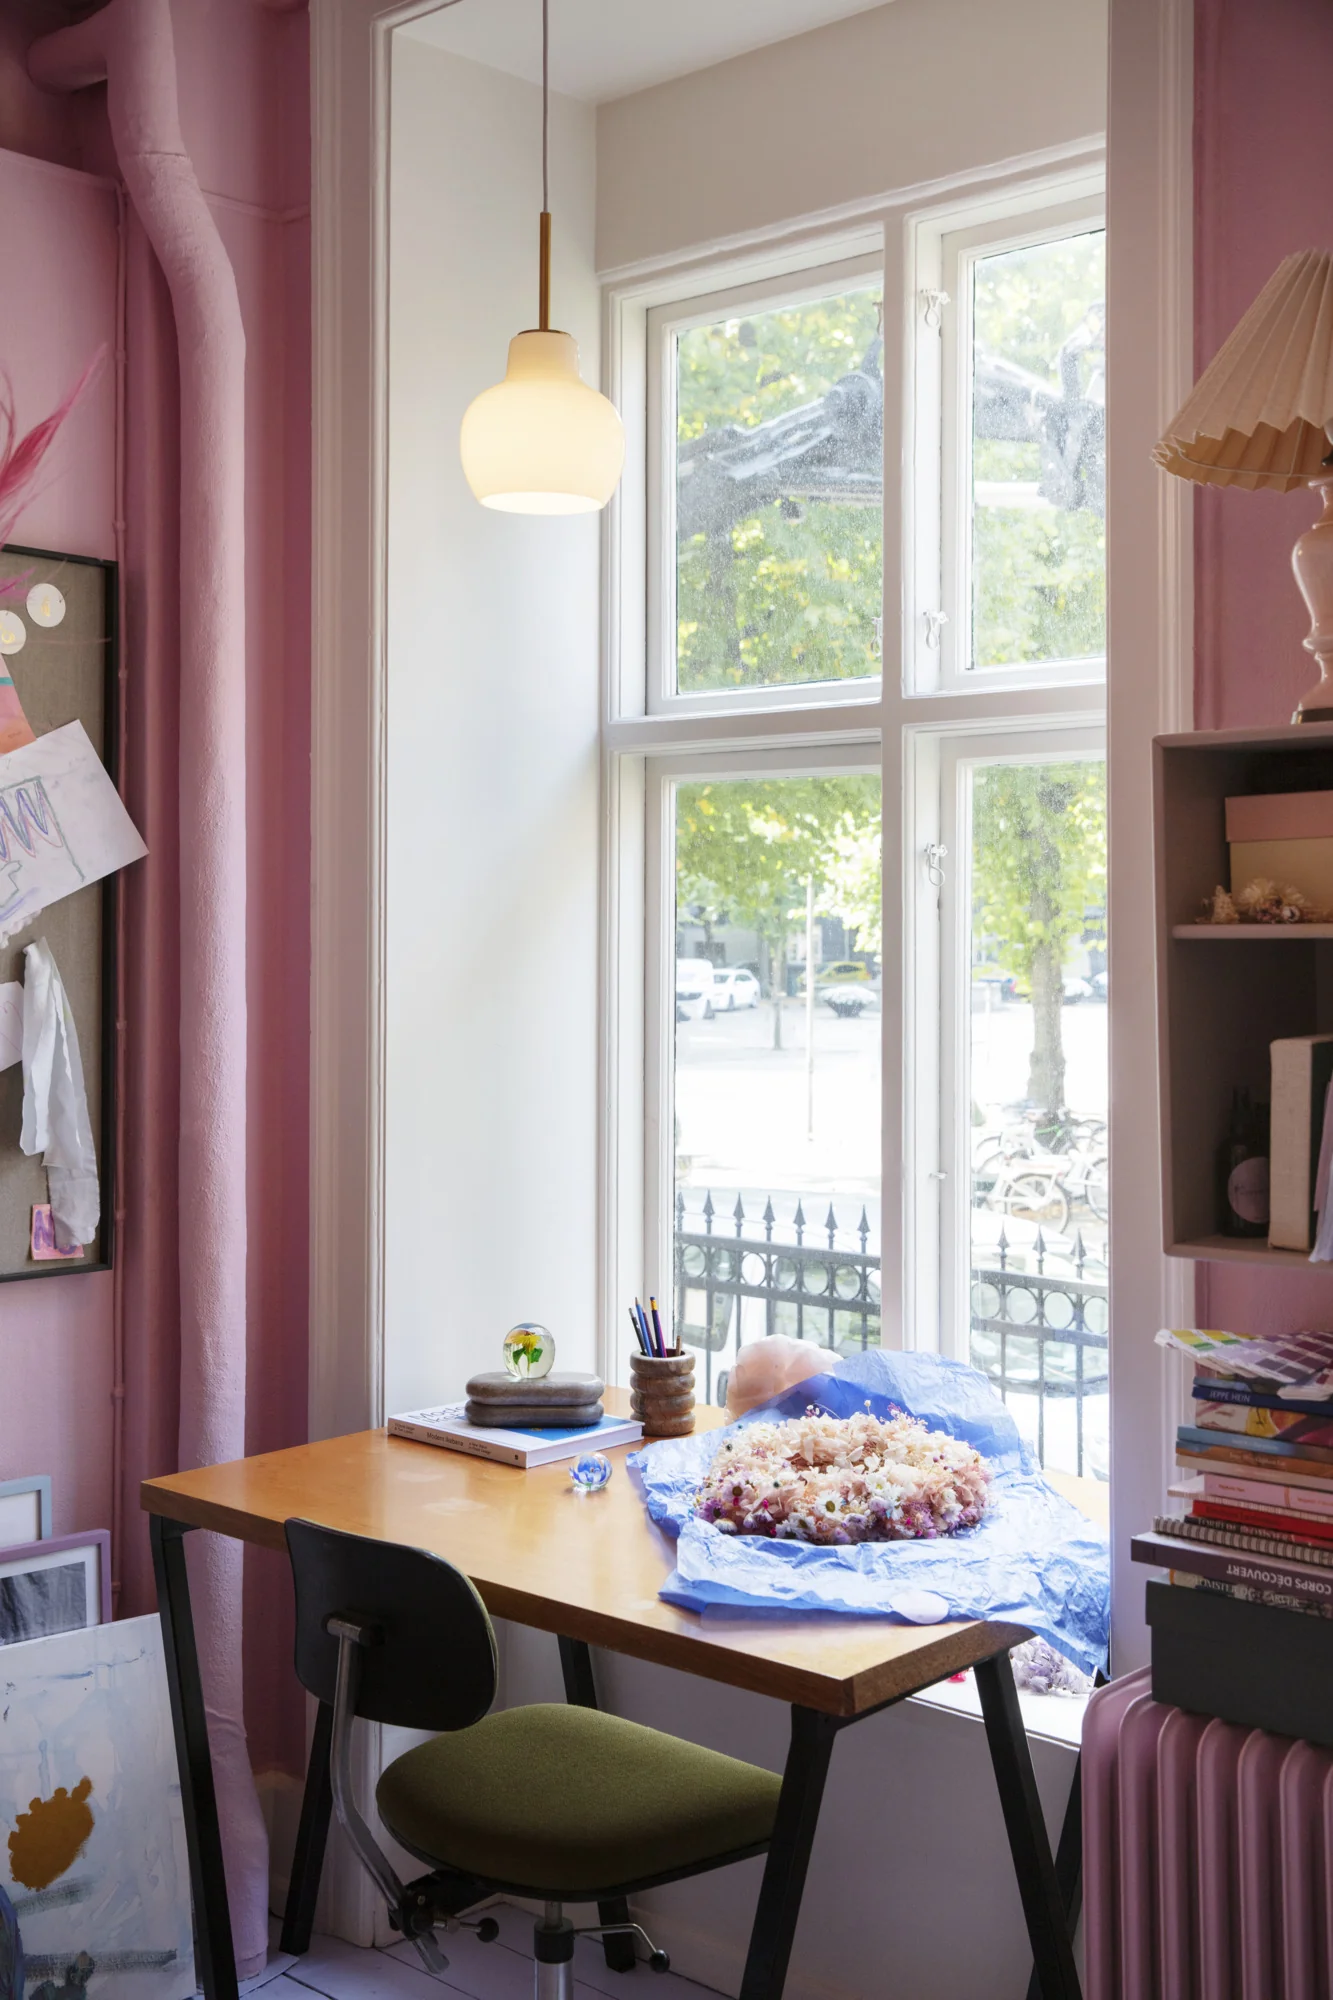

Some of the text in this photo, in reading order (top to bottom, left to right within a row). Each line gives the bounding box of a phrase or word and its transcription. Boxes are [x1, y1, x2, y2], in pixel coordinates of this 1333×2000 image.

[1210, 1390, 1251, 1404] JEPPE HEIN
[426, 1432, 446, 1442] Modern
[1226, 1563, 1332, 1595] CORPS DÉCOUVERT
